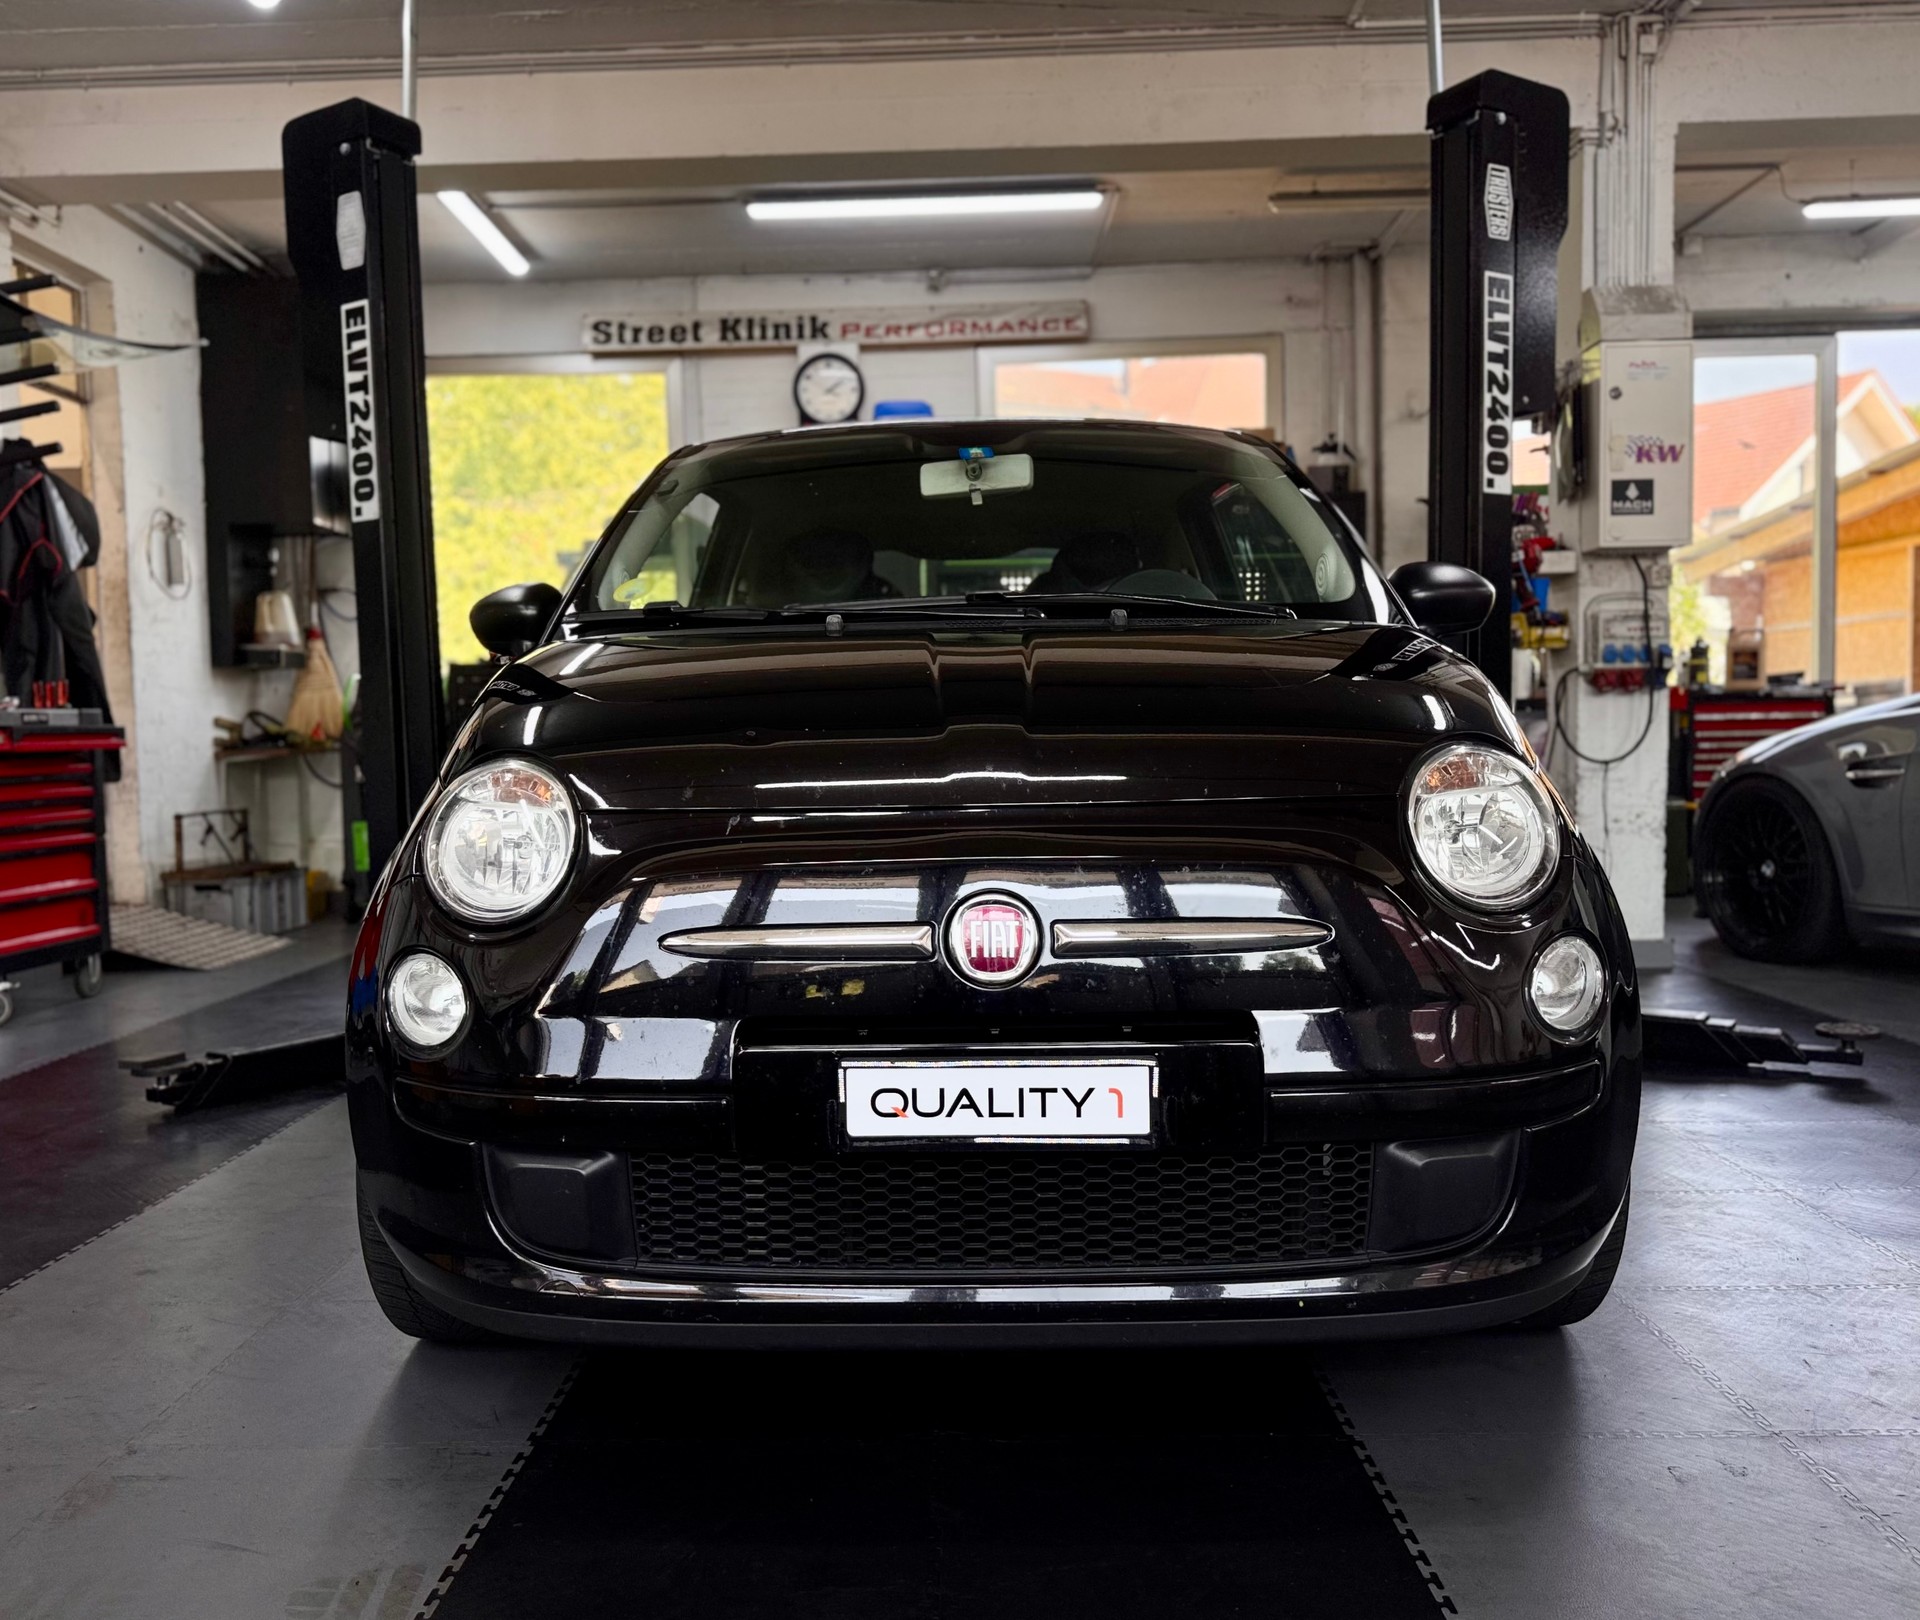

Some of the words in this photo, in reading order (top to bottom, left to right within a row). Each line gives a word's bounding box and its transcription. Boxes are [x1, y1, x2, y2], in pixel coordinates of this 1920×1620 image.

[1487, 170, 1511, 236] TRUSTERS
[592, 319, 703, 344] Street
[719, 316, 829, 342] Klinik
[1635, 444, 1685, 464] KW
[1612, 499, 1652, 509] MACH
[970, 920, 1020, 958] FIAT
[870, 1087, 1096, 1118] QUALITY
[1108, 1087, 1124, 1118] 1
